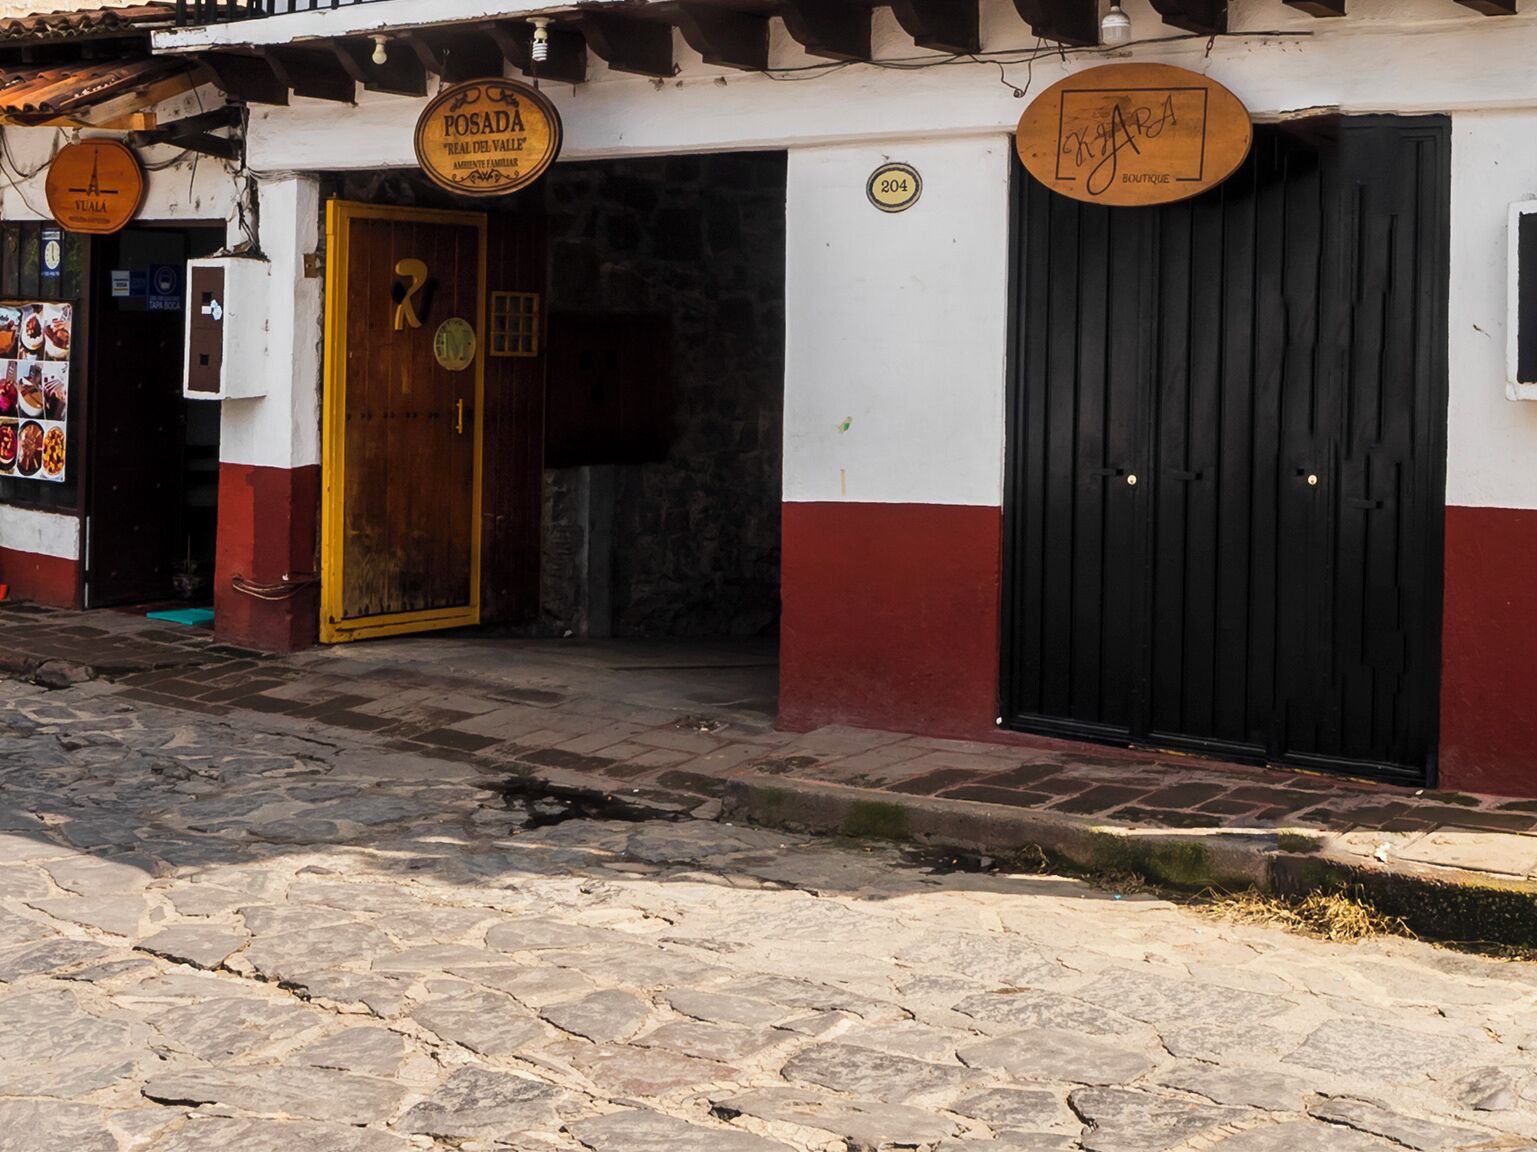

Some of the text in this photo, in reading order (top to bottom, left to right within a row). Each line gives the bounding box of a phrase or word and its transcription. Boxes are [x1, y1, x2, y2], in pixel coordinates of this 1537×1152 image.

[444, 109, 525, 137] POSADA
[473, 140, 491, 154] DEL
[453, 158, 519, 170] AMBIENTE FAMILIAR
[881, 179, 908, 193] 204
[1122, 173, 1170, 185] BOUTIQUE
[75, 199, 107, 214] VUALÁ
